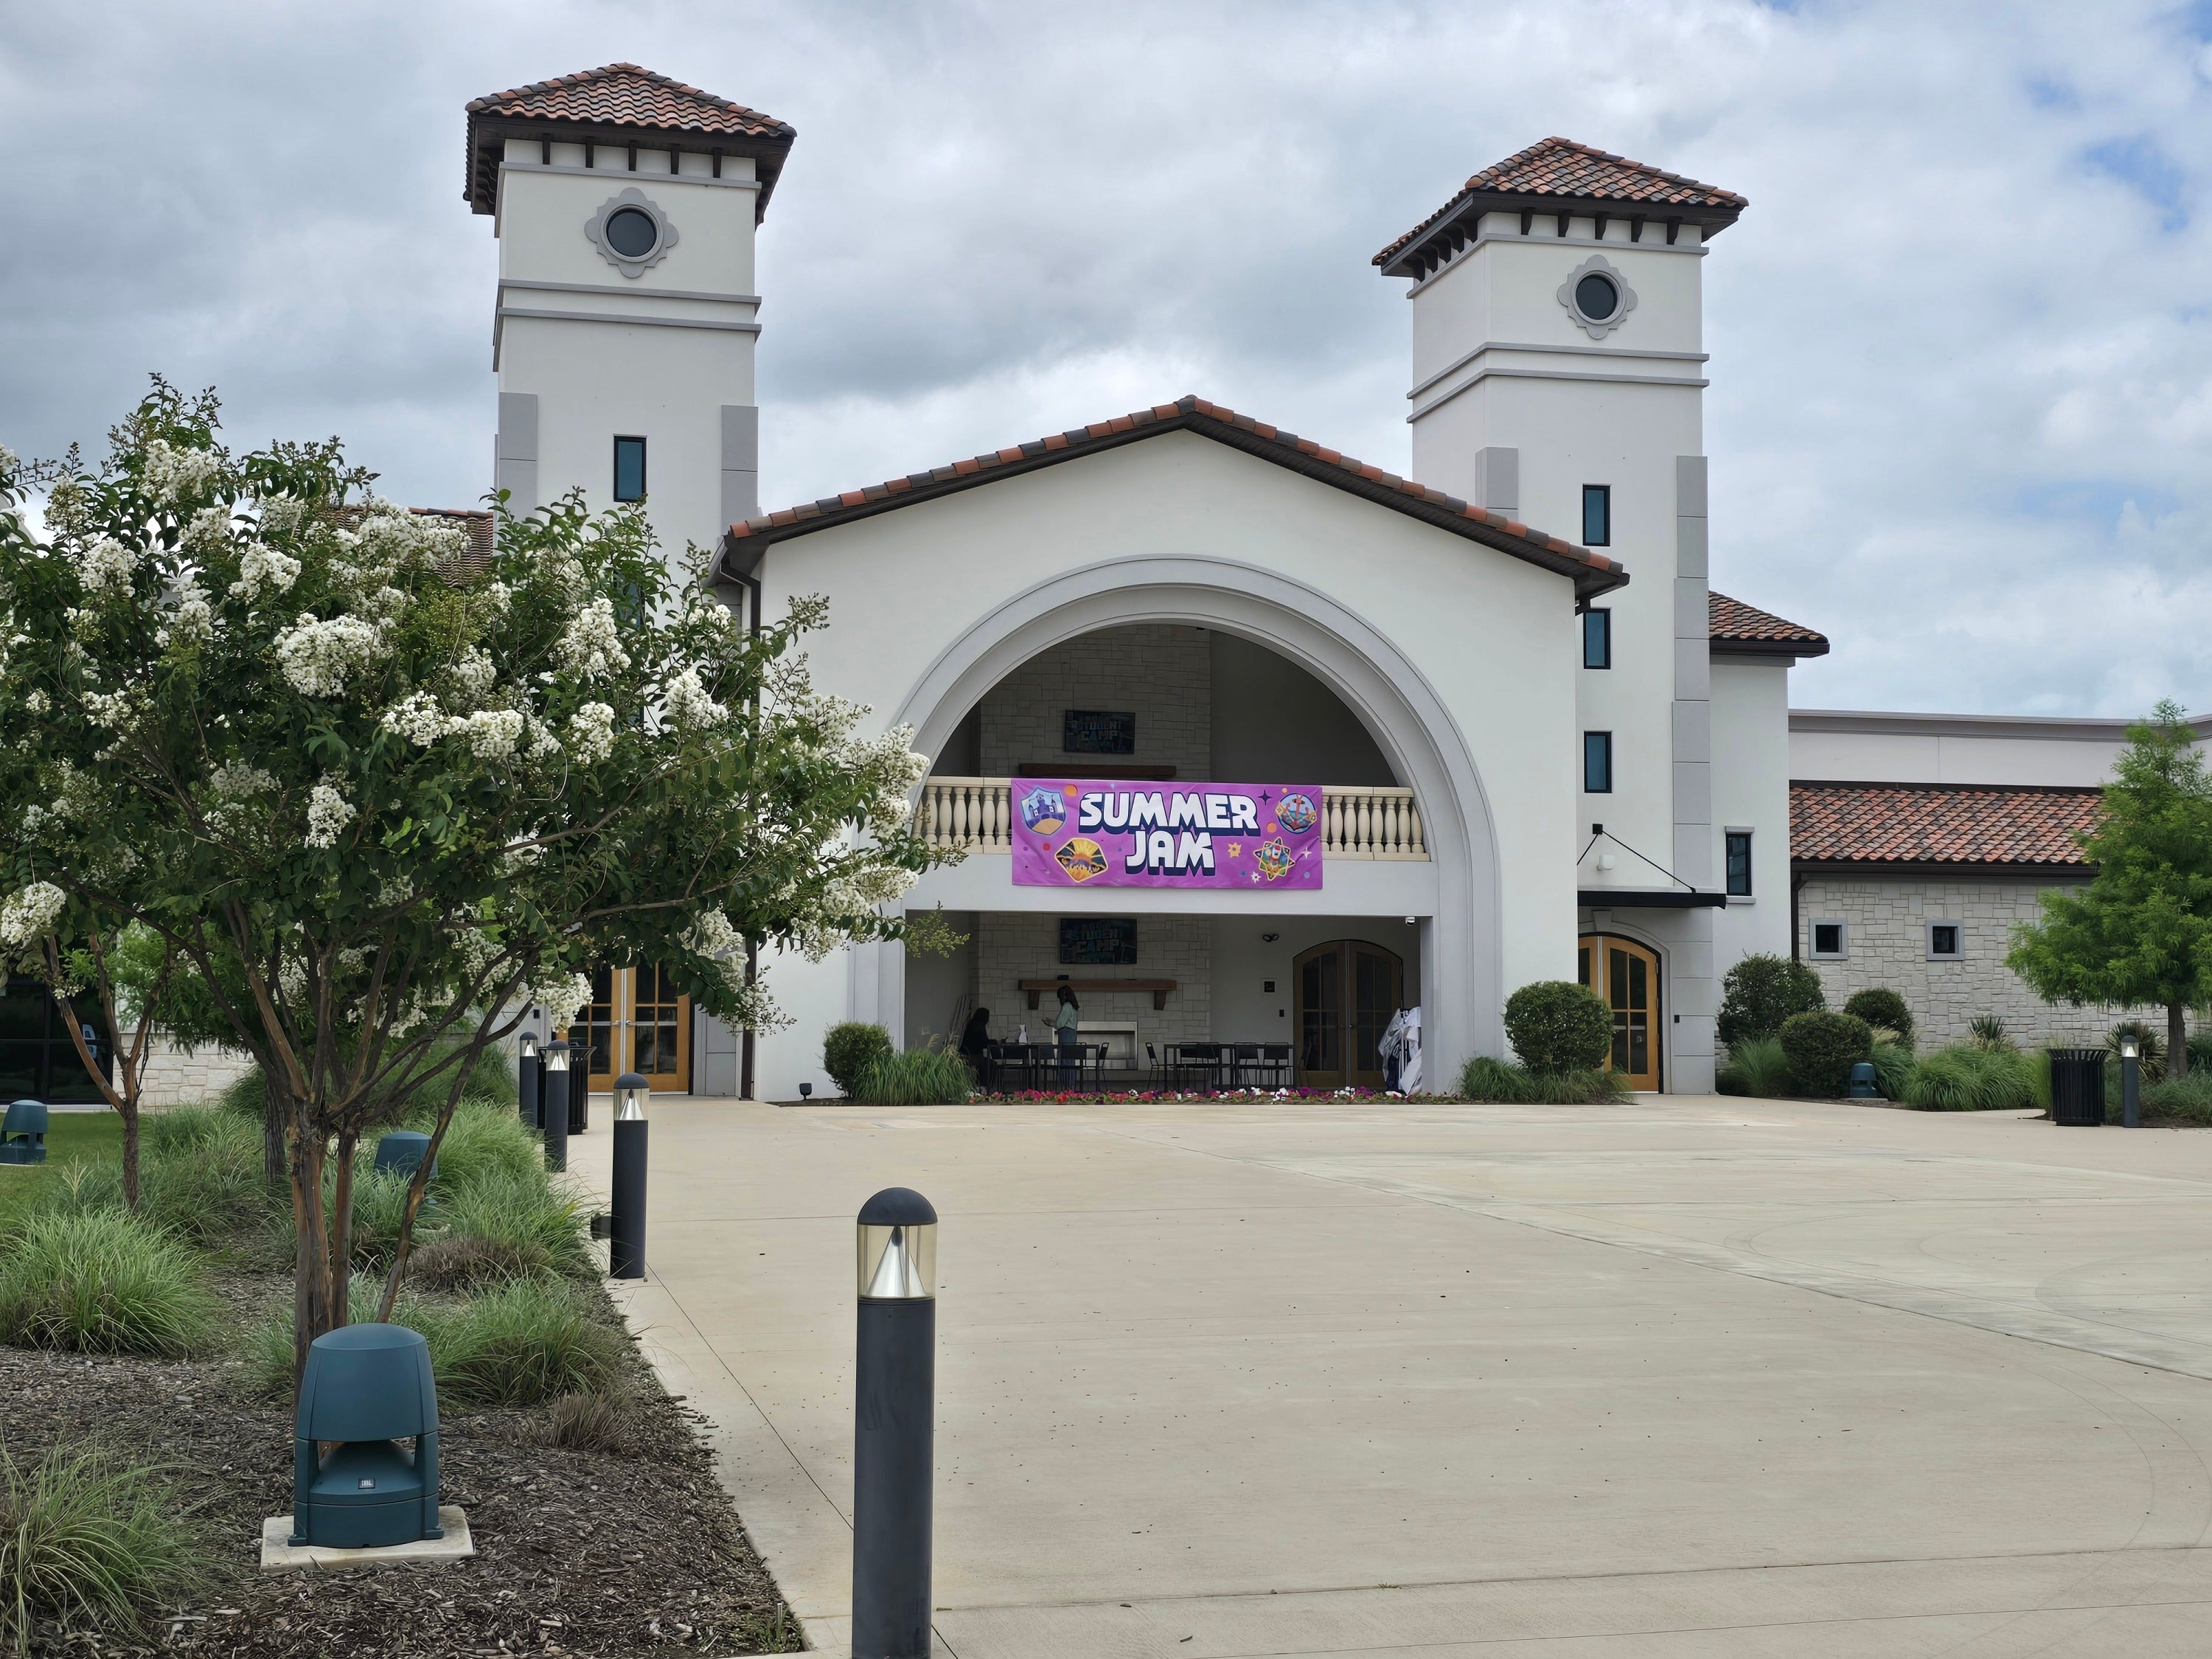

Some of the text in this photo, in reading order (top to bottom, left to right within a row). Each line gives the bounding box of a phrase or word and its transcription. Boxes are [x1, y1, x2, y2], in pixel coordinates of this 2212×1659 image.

[1079, 730, 1120, 741] CAMP
[1079, 792, 1260, 836] SUMMER
[1125, 830, 1215, 876] JAM
[1077, 939, 1120, 953] CAMP
